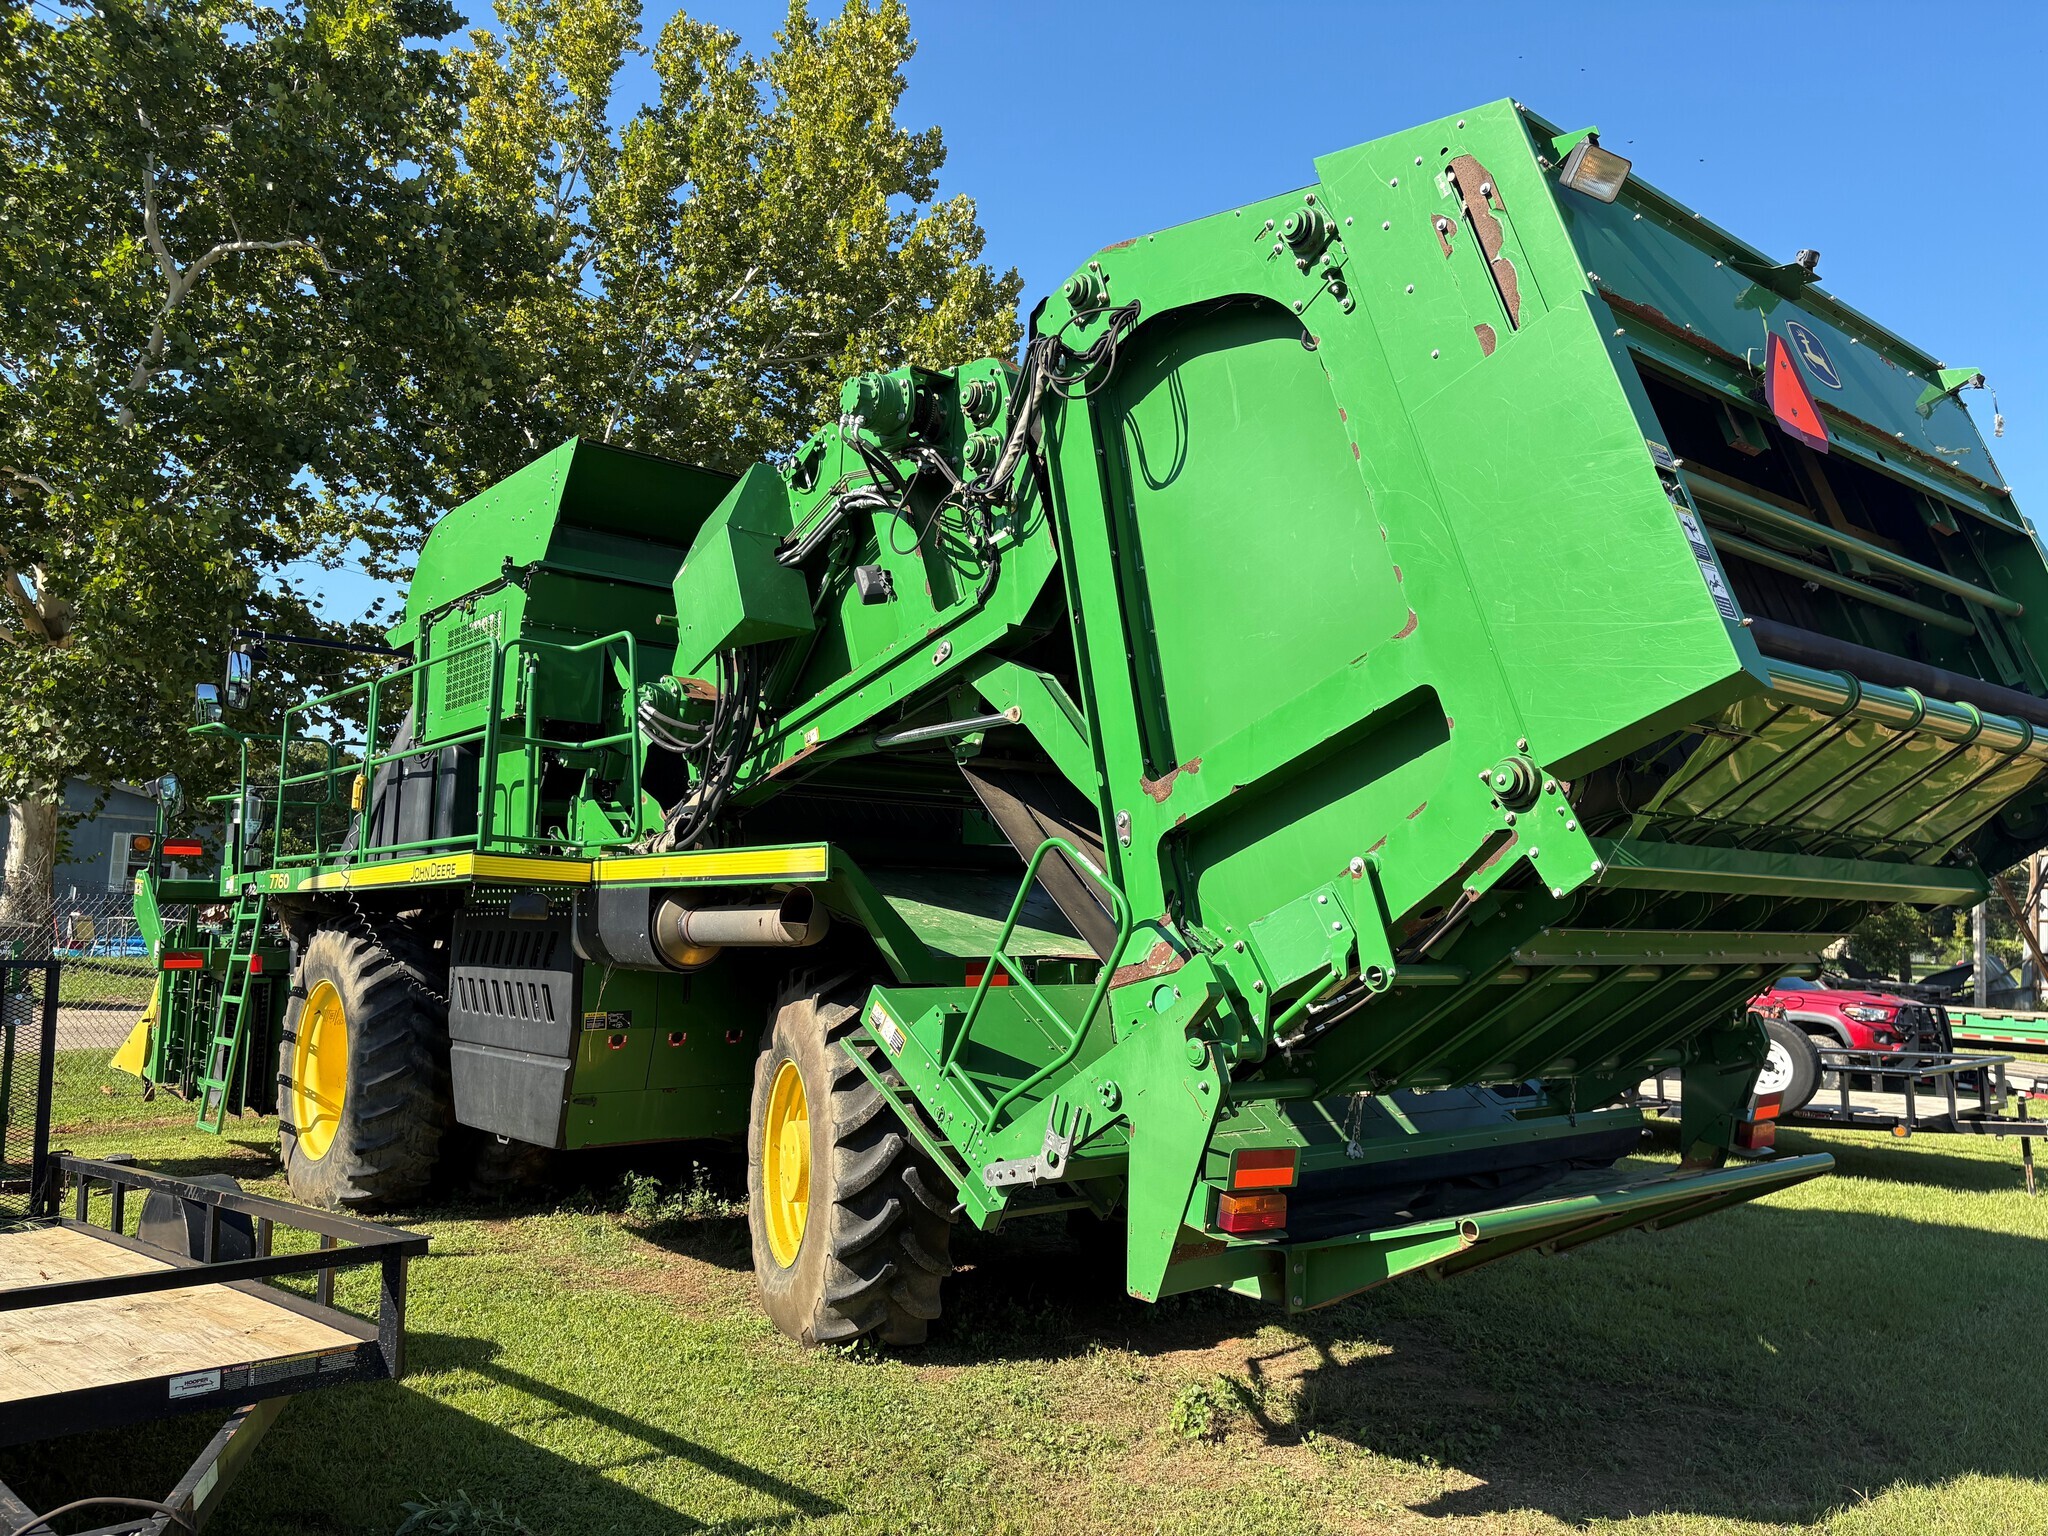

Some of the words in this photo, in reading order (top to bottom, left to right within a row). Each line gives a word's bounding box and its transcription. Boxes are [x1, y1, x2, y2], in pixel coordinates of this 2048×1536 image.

[410, 865, 430, 880] JOHN
[431, 862, 456, 877] DEERE
[269, 871, 290, 890] 7760
[184, 1377, 209, 1386] HOOPER
